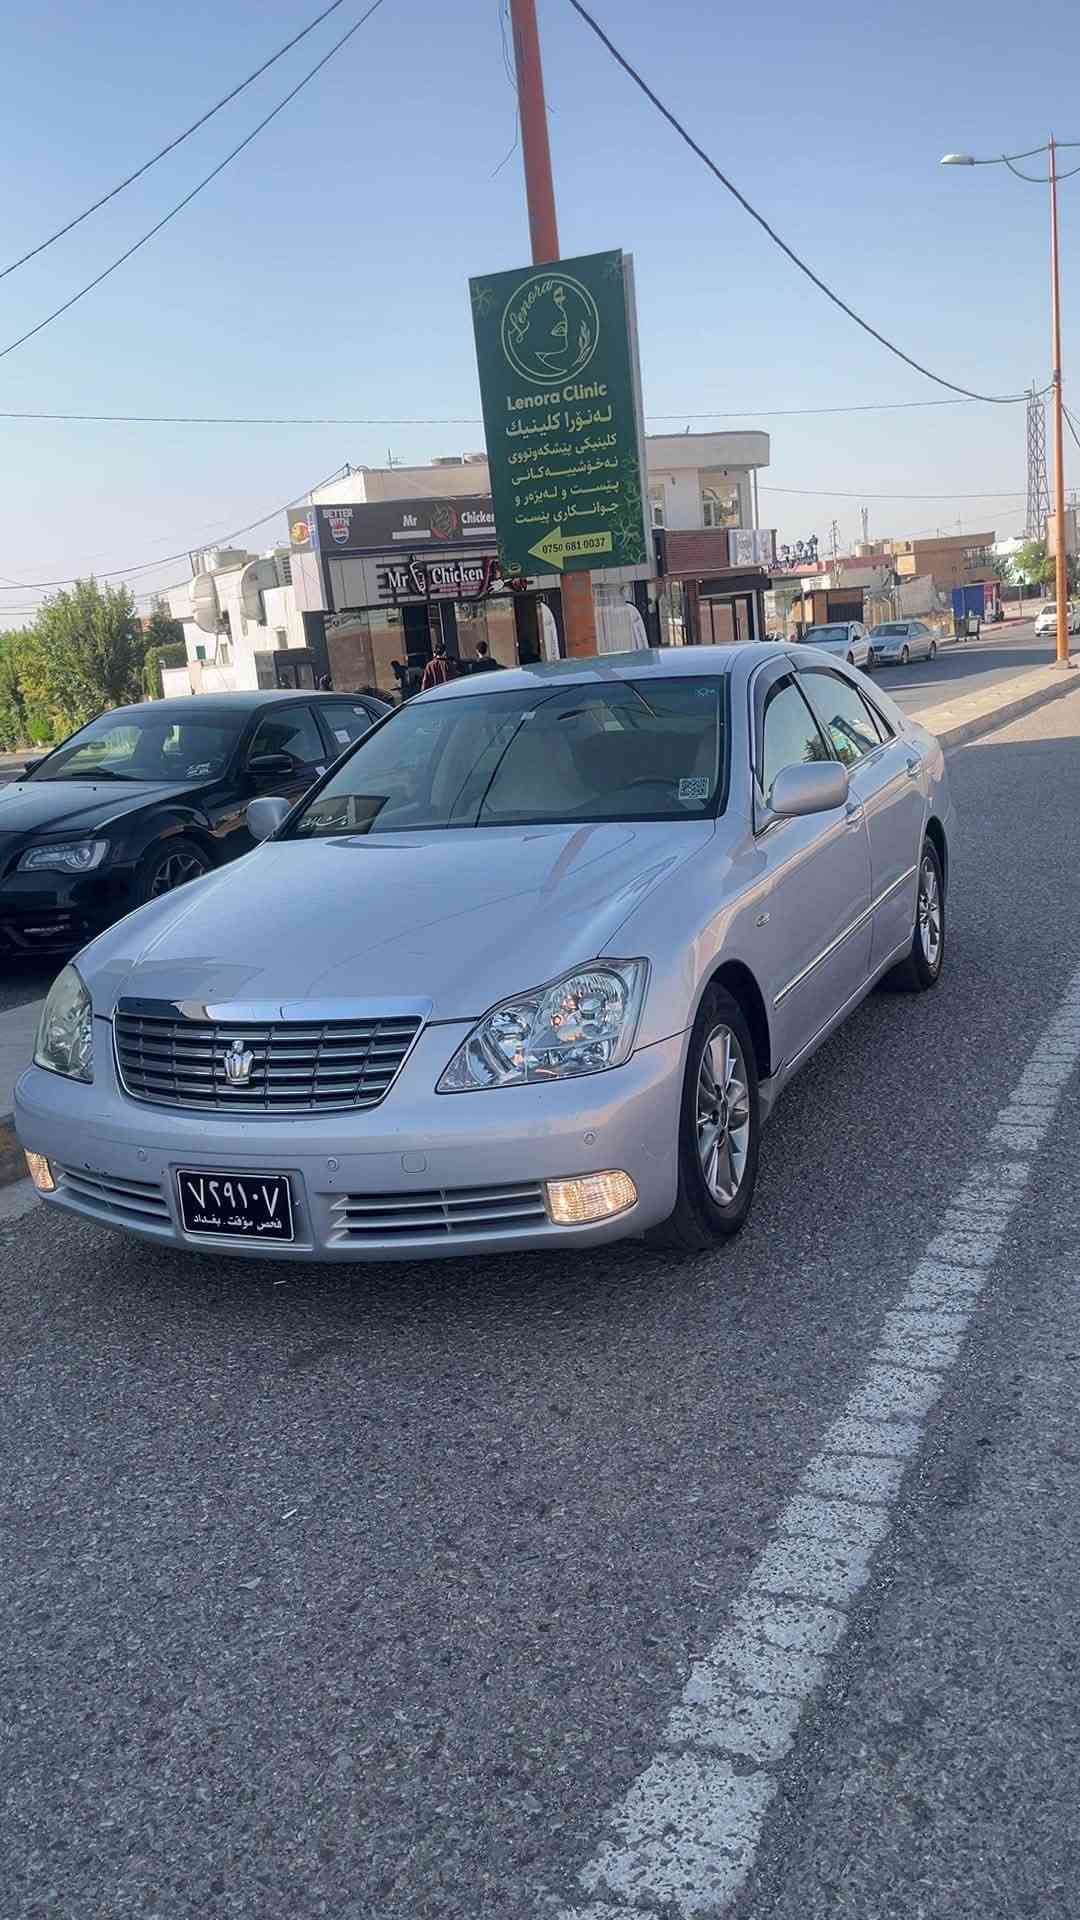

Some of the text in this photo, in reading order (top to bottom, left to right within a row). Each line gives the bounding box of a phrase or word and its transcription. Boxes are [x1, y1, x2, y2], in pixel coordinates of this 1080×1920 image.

[508, 280, 553, 343] Lenora
[507, 382, 607, 410] Lenora Clinic
[403, 514, 418, 528] Mr
[542, 537, 606, 554] 0750 681 0037
[388, 565, 484, 589] Mr Chicken
[193, 1214, 221, 1228] بغداد
